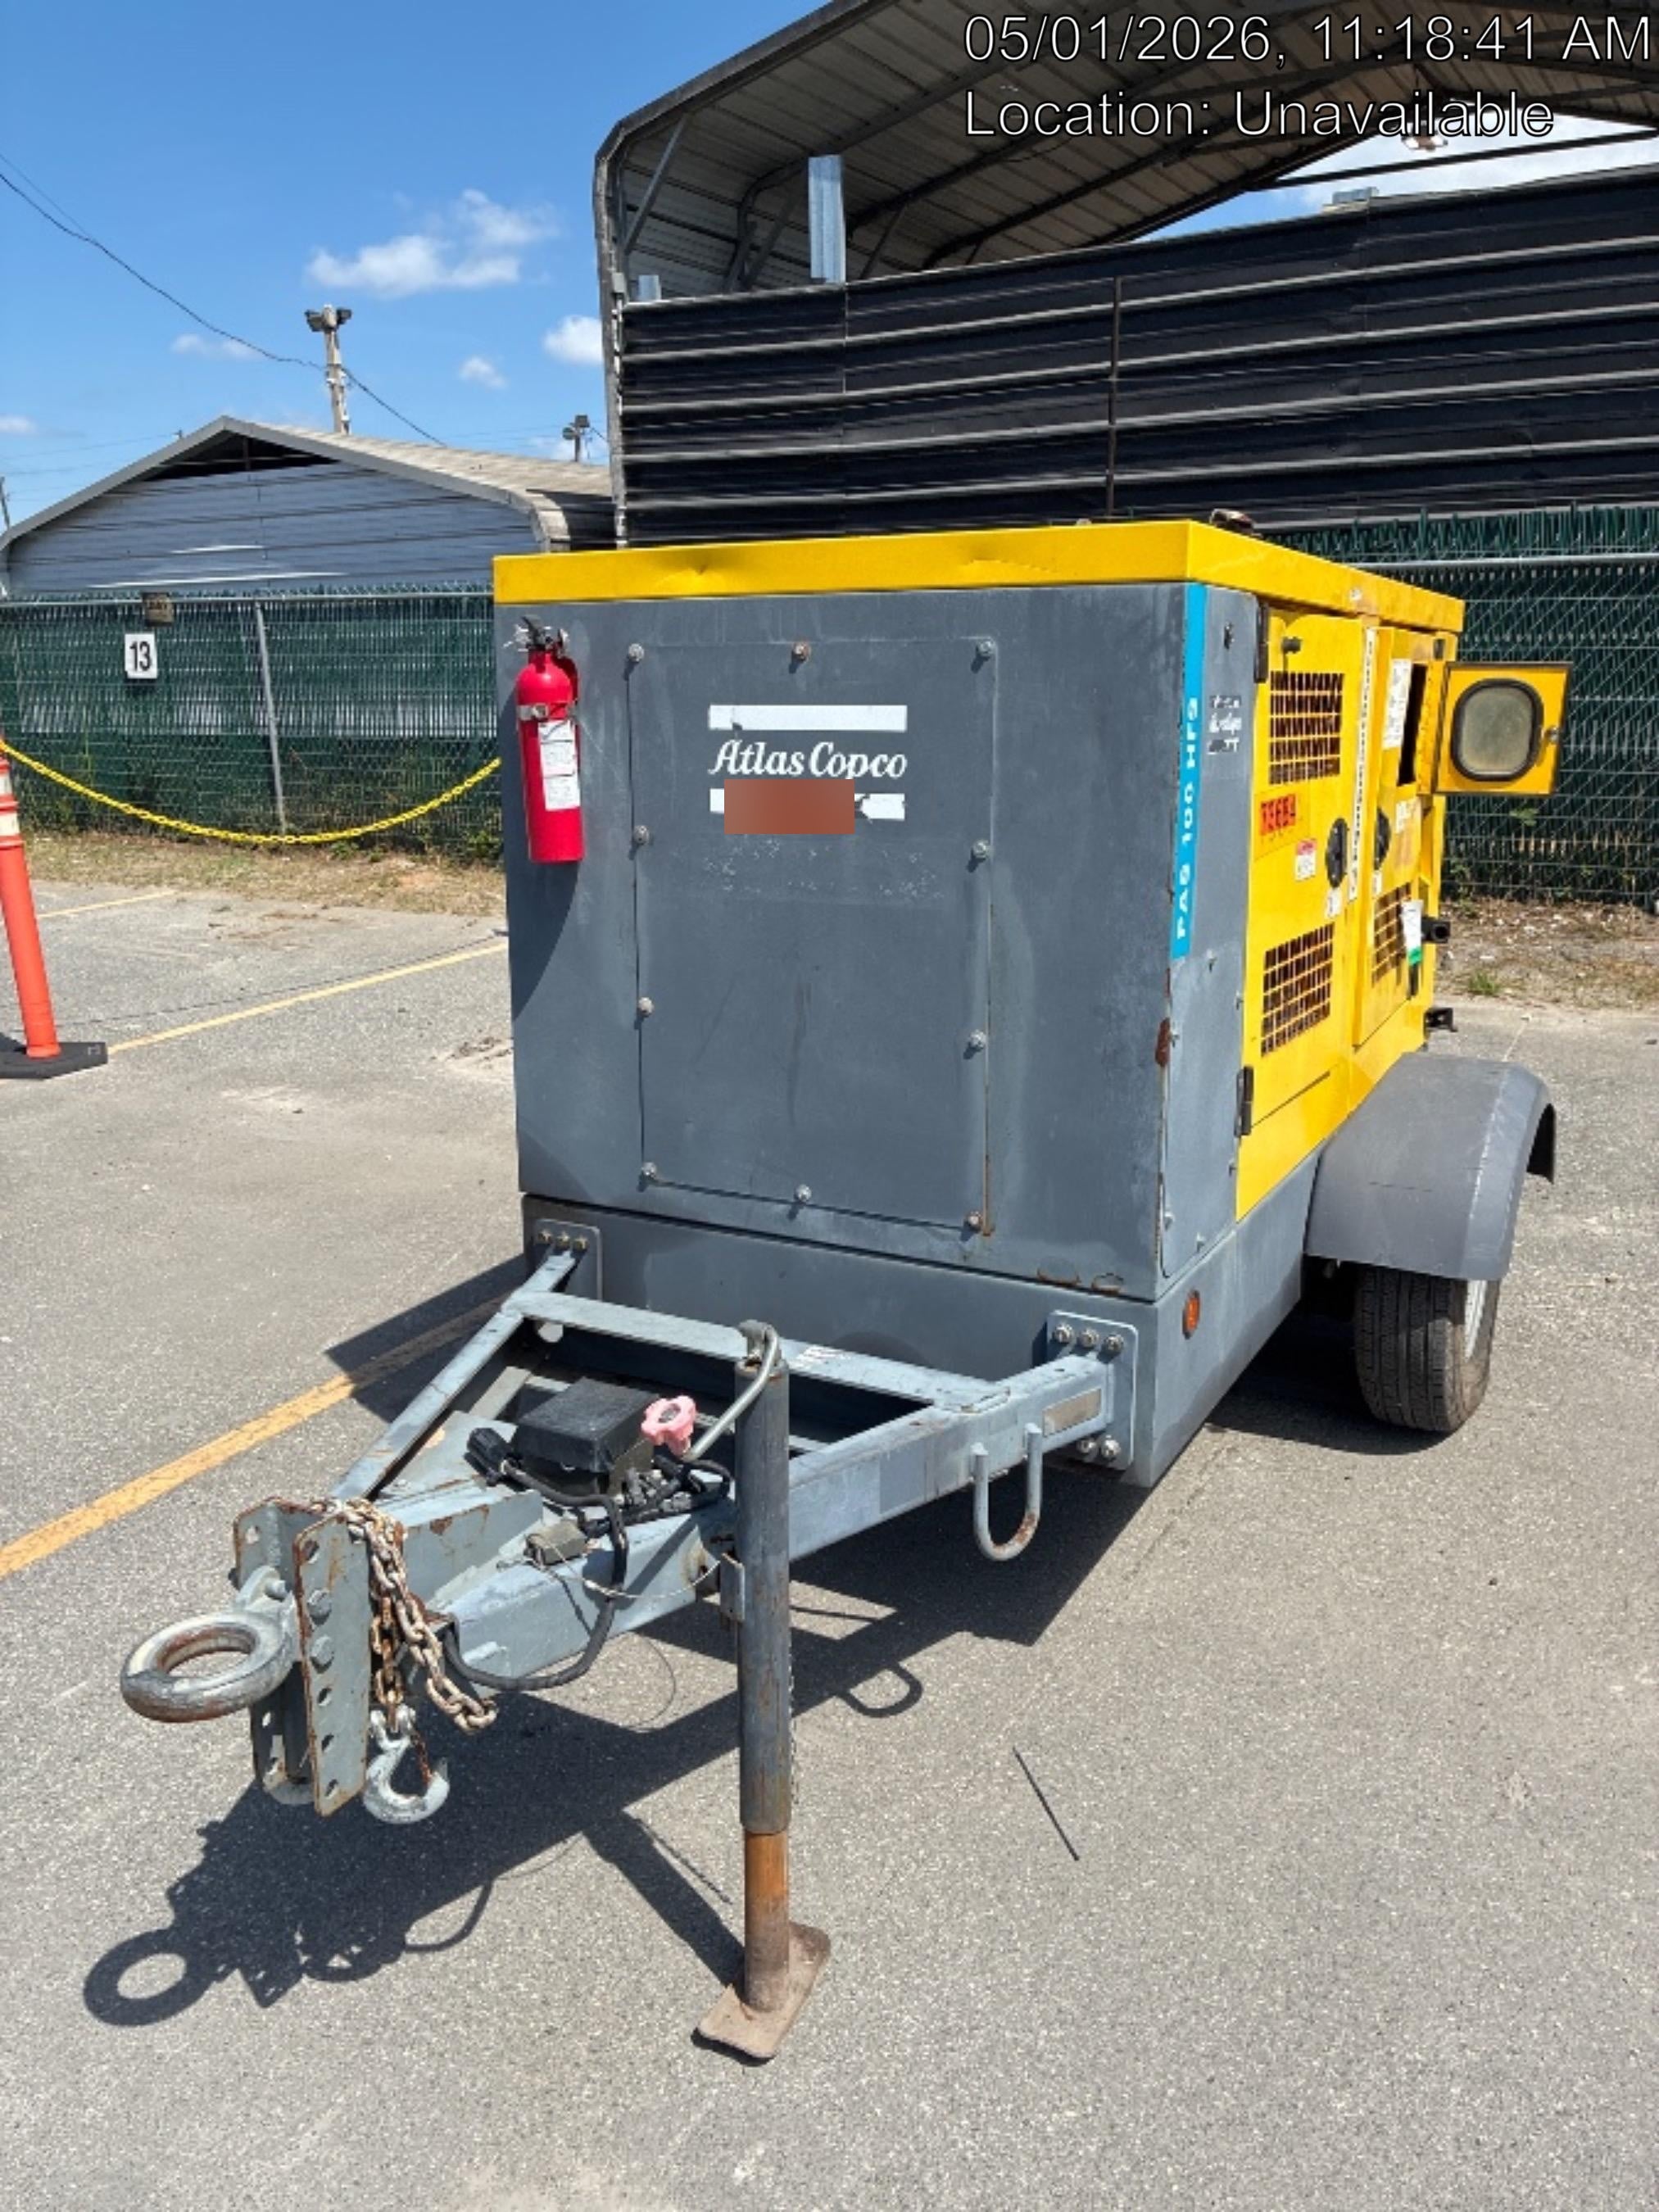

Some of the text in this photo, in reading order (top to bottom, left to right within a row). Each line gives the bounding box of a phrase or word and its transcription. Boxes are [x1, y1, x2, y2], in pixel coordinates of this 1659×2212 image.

[129, 641, 152, 672] 13
[708, 739, 907, 779] Atlas Copco
